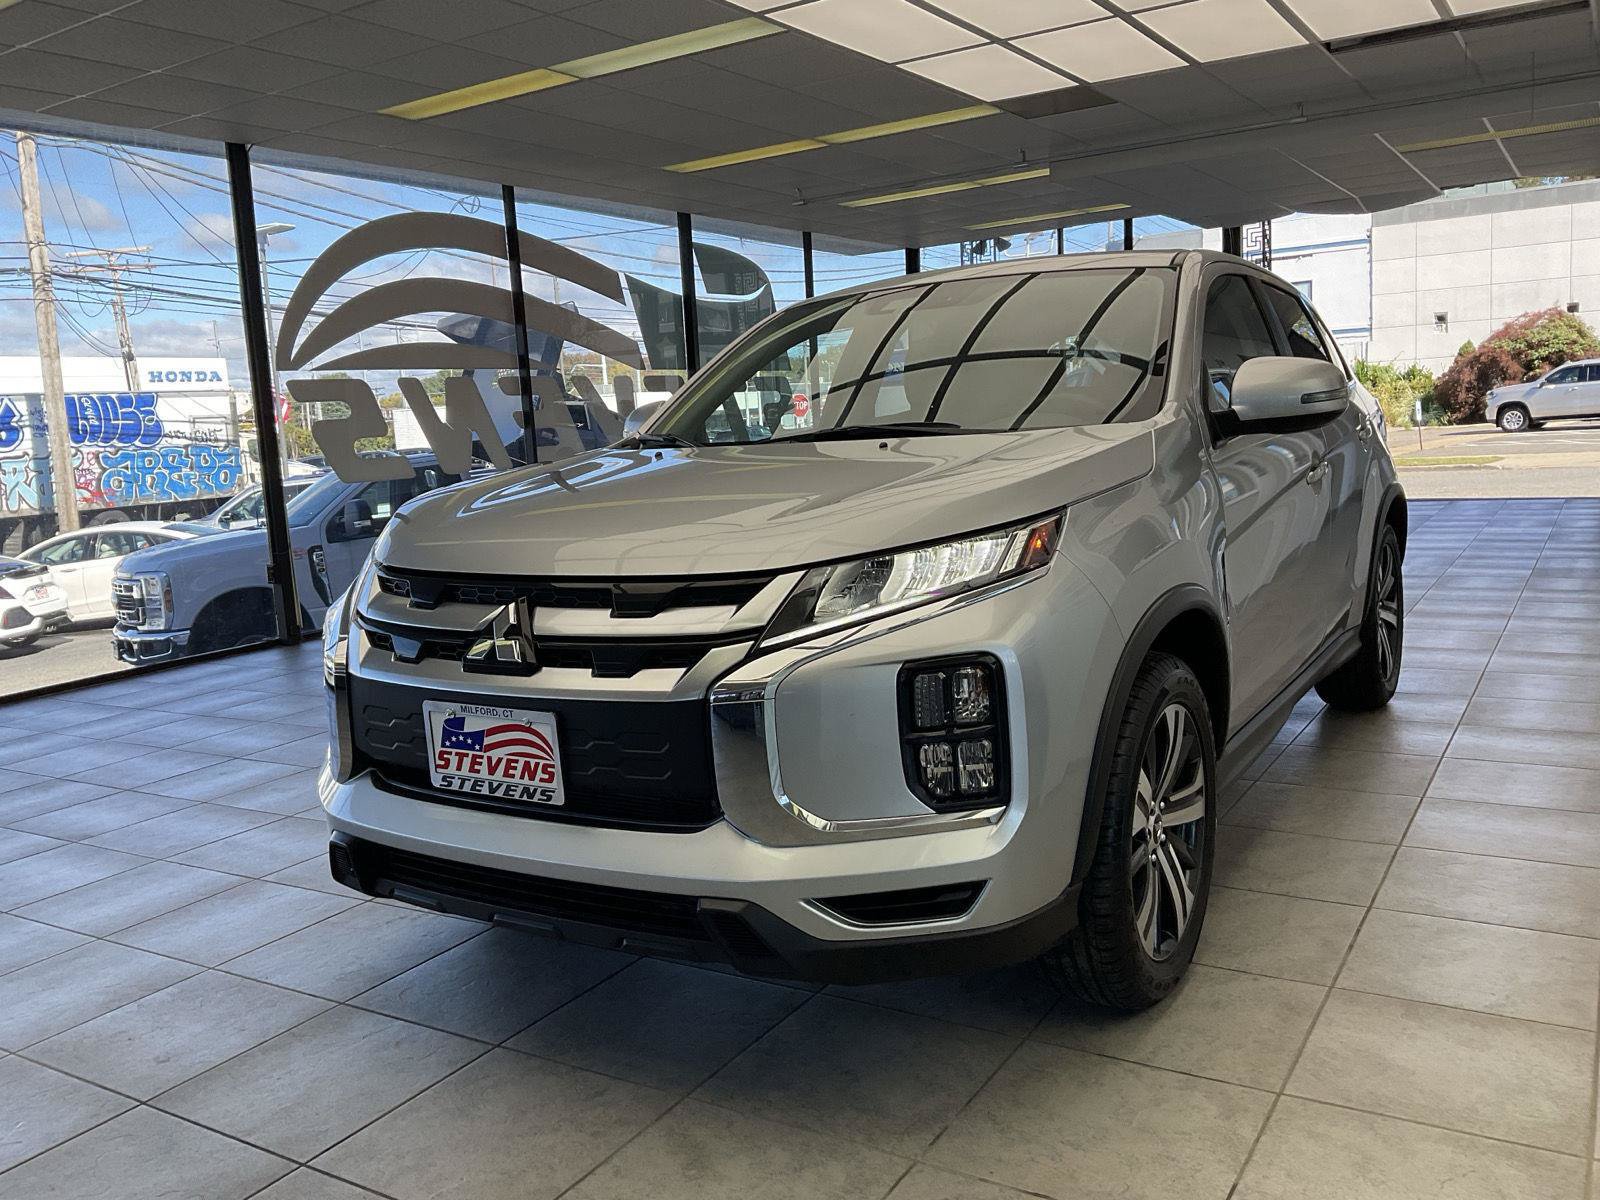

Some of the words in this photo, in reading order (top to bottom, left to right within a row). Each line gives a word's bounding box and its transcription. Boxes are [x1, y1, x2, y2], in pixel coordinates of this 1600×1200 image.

[148, 370, 223, 383] HONDA
[460, 705, 501, 718] MILFORD,
[502, 709, 514, 719] CT
[435, 749, 556, 784] STEVENS
[439, 774, 558, 803] STEVENS
